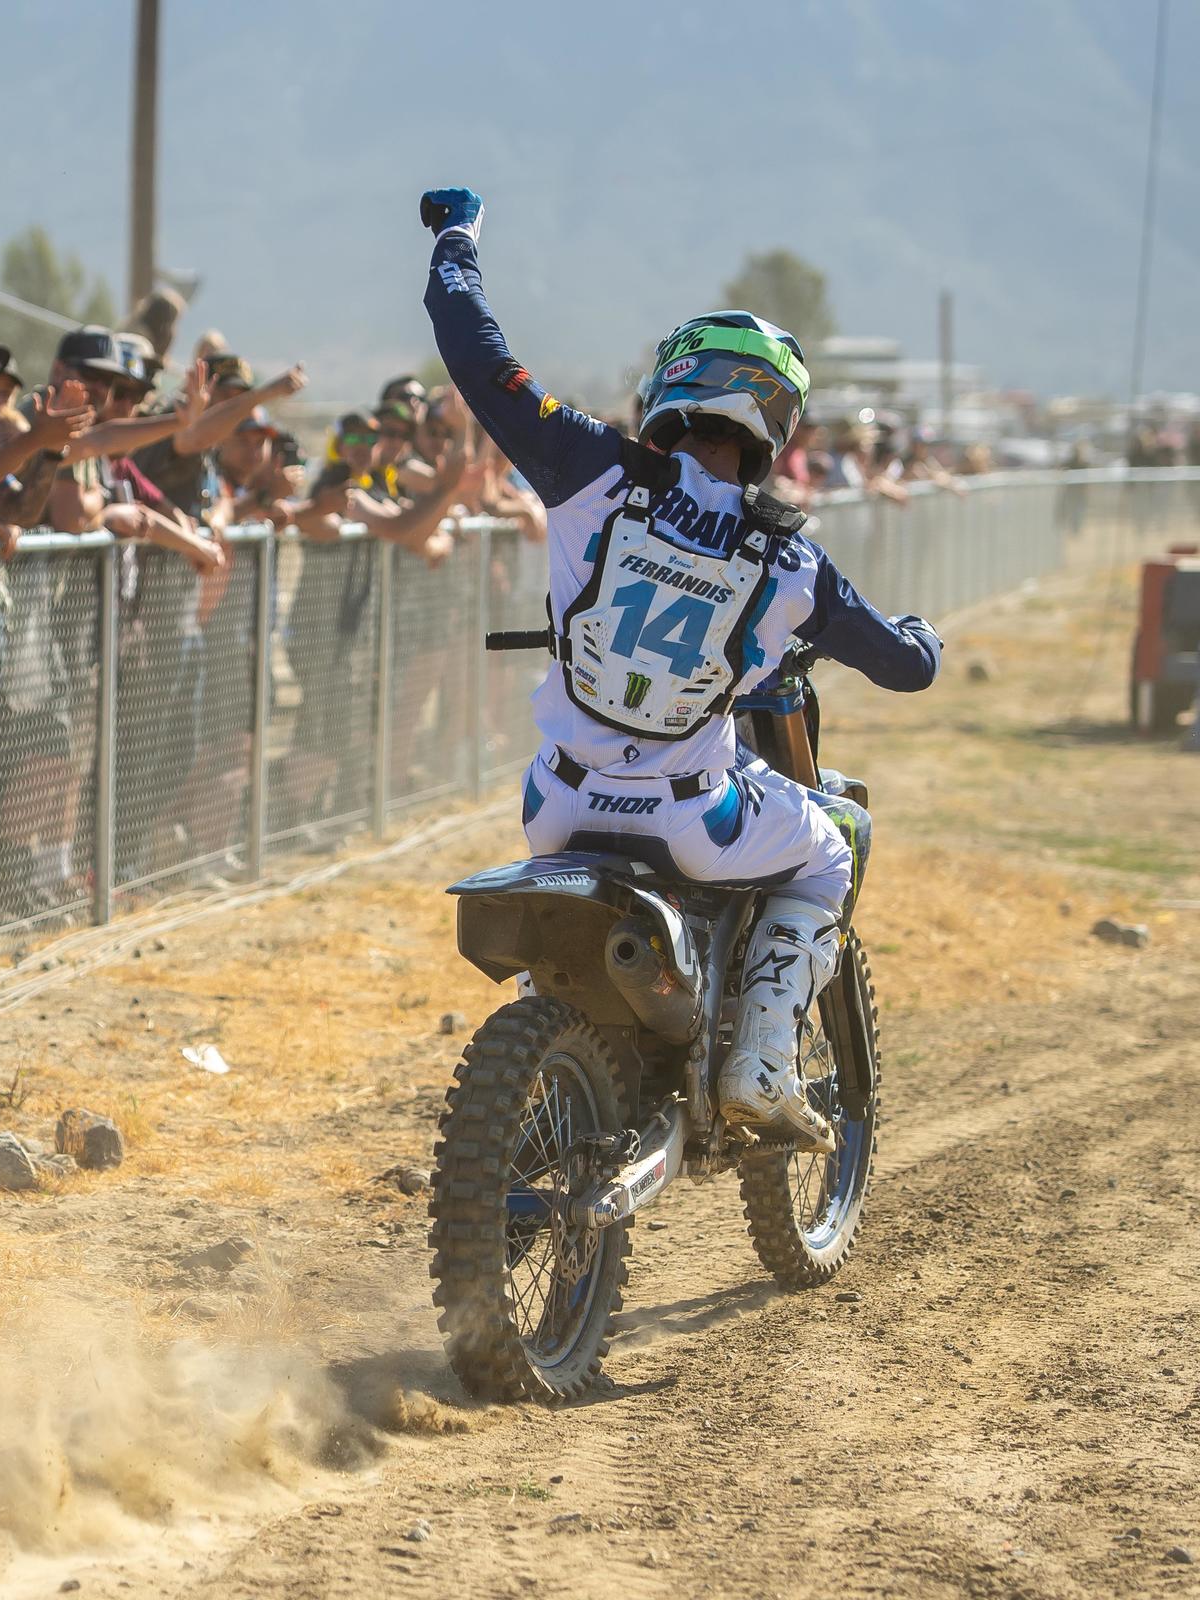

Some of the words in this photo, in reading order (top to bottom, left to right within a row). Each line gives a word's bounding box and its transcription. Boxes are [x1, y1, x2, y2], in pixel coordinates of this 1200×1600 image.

[666, 360, 693, 378] BELL
[618, 554, 734, 604] FERRANDIS
[608, 579, 716, 680] 14
[588, 791, 663, 815] THOR
[535, 873, 591, 888] DUNLOP
